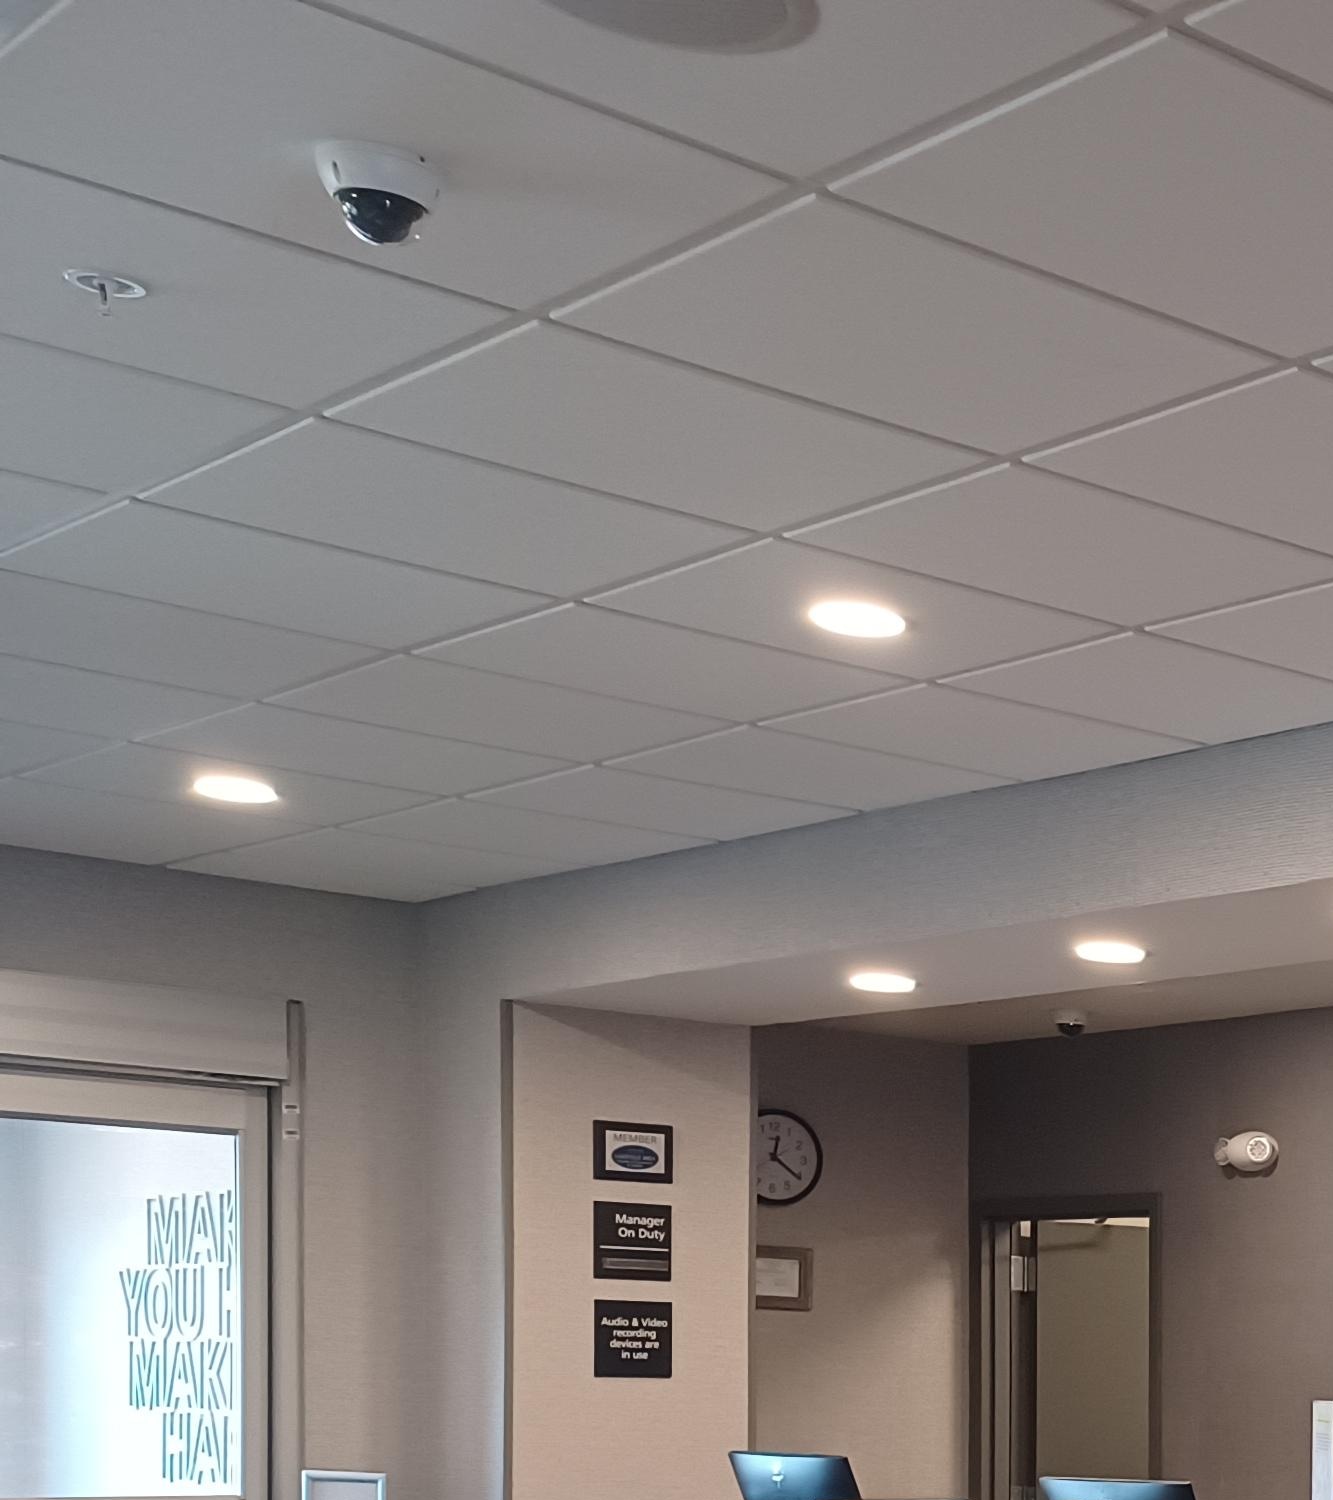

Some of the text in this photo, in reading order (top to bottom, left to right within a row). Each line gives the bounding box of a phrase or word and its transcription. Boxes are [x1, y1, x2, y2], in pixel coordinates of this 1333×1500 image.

[615, 1213, 665, 1228] Manager
[618, 1227, 665, 1242] On Duty
[601, 1316, 629, 1327] Audio
[641, 1317, 668, 1328] Video
[613, 1328, 656, 1340] recording
[609, 1338, 659, 1350] devices are
[621, 1349, 648, 1360] in use
[129, 1338, 233, 1410] MAK
